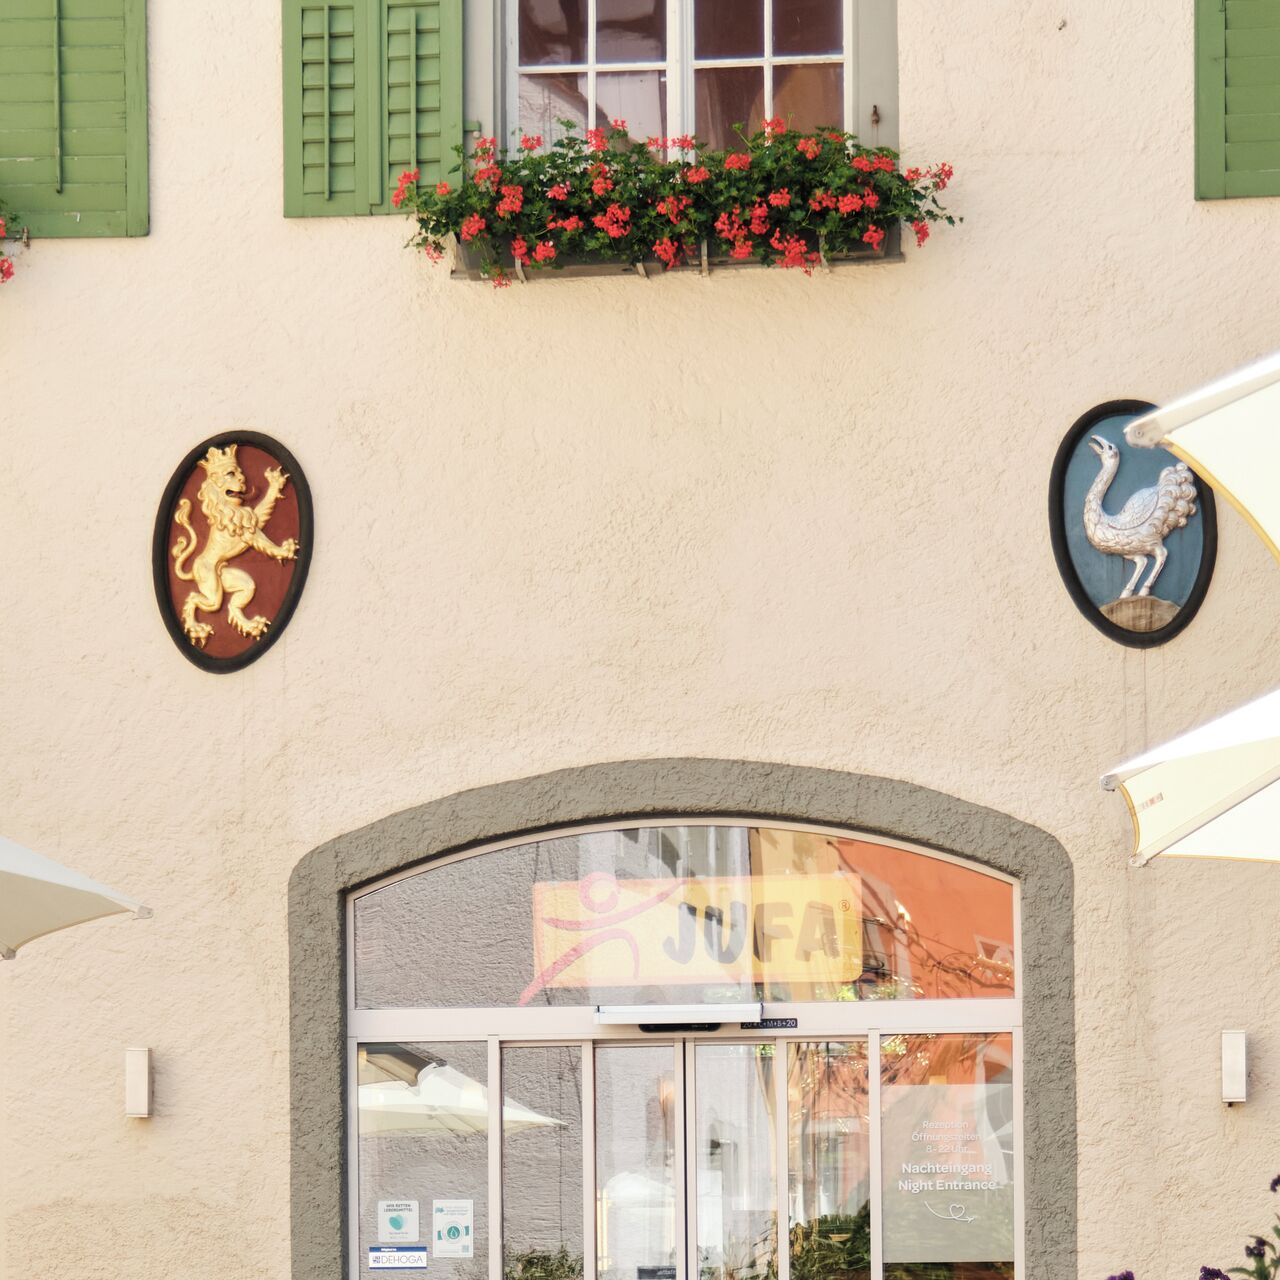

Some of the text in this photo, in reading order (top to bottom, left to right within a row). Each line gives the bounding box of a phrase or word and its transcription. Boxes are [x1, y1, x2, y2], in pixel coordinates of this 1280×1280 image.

[662, 900, 840, 965] JUFA
[922, 1120, 968, 1130] Rezeption
[911, 1132, 981, 1142] Öffnungszeiten
[951, 1145, 968, 1153] Uhr
[901, 1162, 993, 1175] Nachteingang
[898, 1180, 997, 1193] Night Entrance
[381, 1255, 423, 1264] DEHOGA
